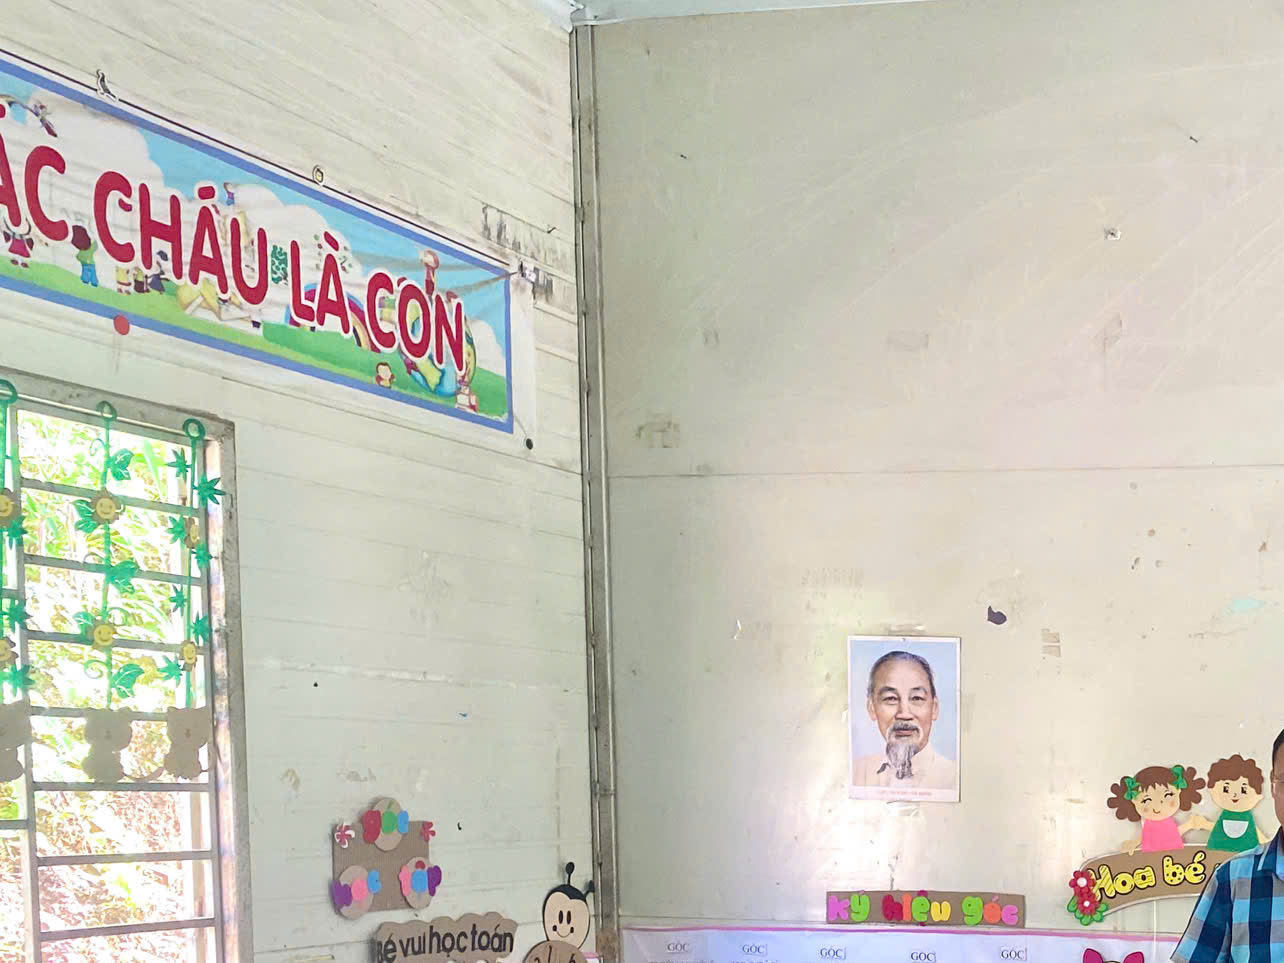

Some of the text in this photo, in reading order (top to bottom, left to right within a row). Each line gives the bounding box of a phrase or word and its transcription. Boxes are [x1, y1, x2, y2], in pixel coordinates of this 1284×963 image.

[94, 170, 268, 305] CHÁU
[290, 231, 351, 335] LÀ
[367, 272, 464, 371] CON
[1088, 851, 1206, 901] Hoa bé
